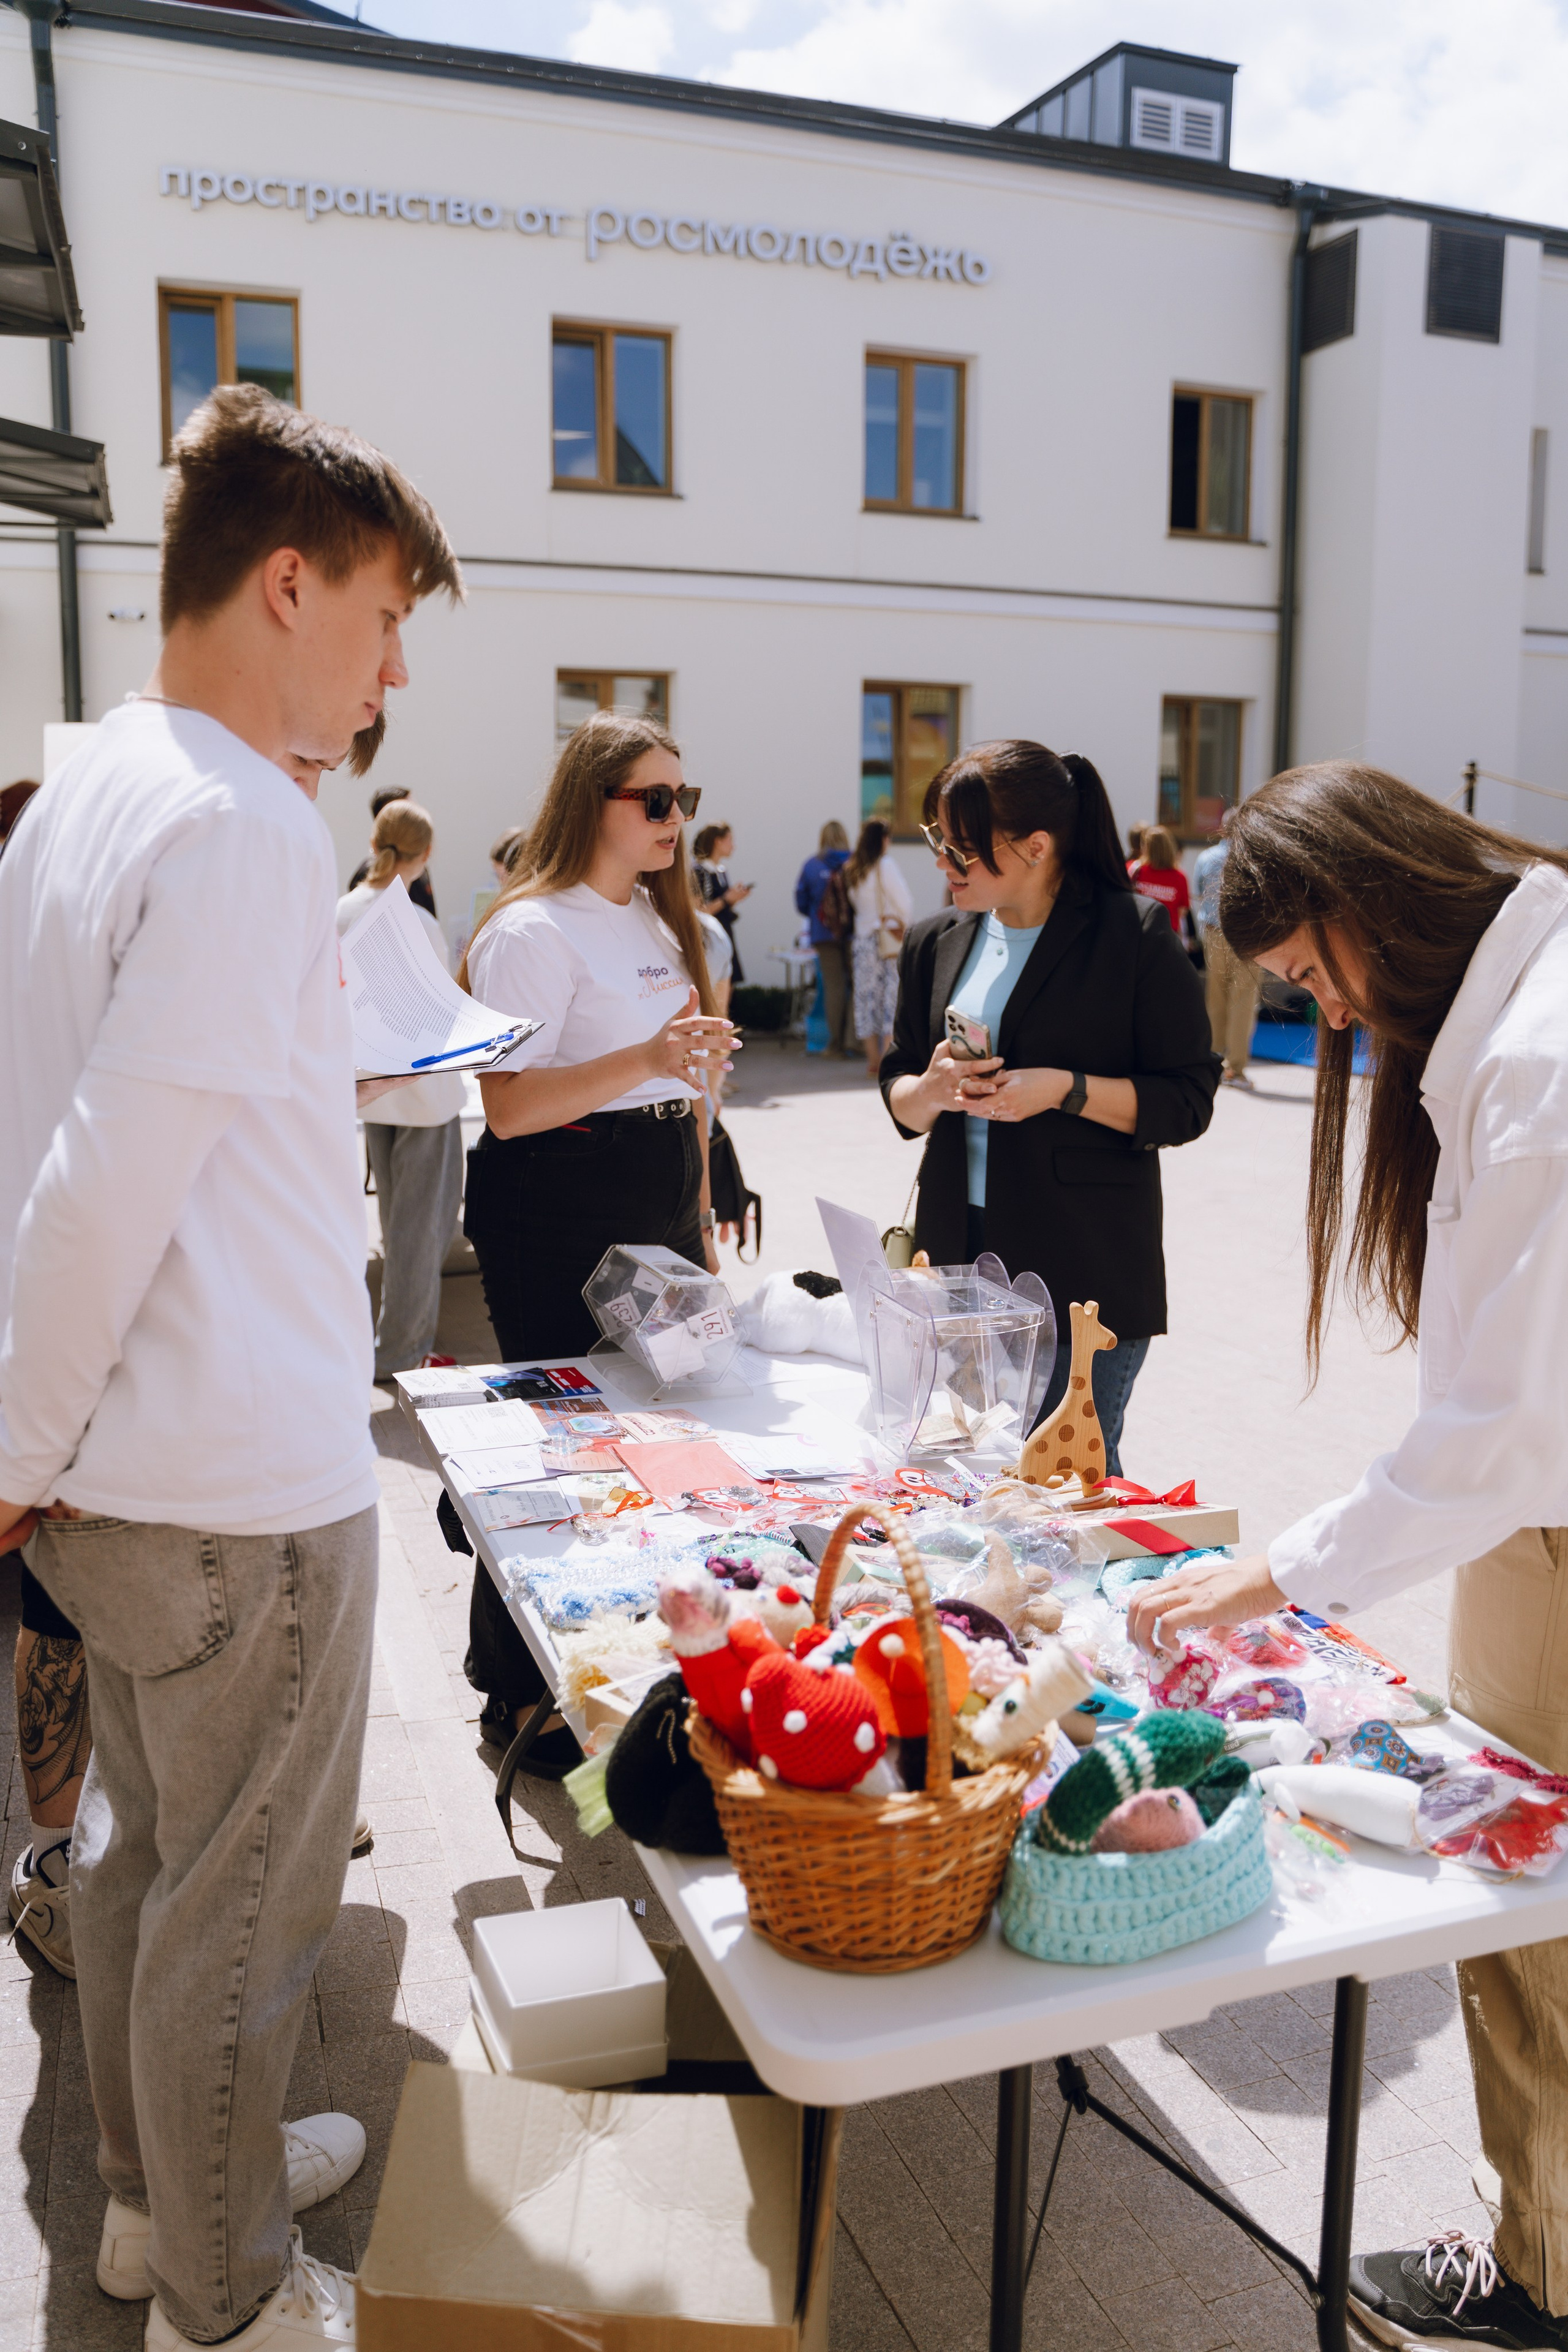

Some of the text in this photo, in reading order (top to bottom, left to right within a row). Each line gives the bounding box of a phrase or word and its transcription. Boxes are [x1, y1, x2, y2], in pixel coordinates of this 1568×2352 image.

[159, 165, 992, 285] пространство от росмолодёжь
[700, 1311, 723, 1340] 291
